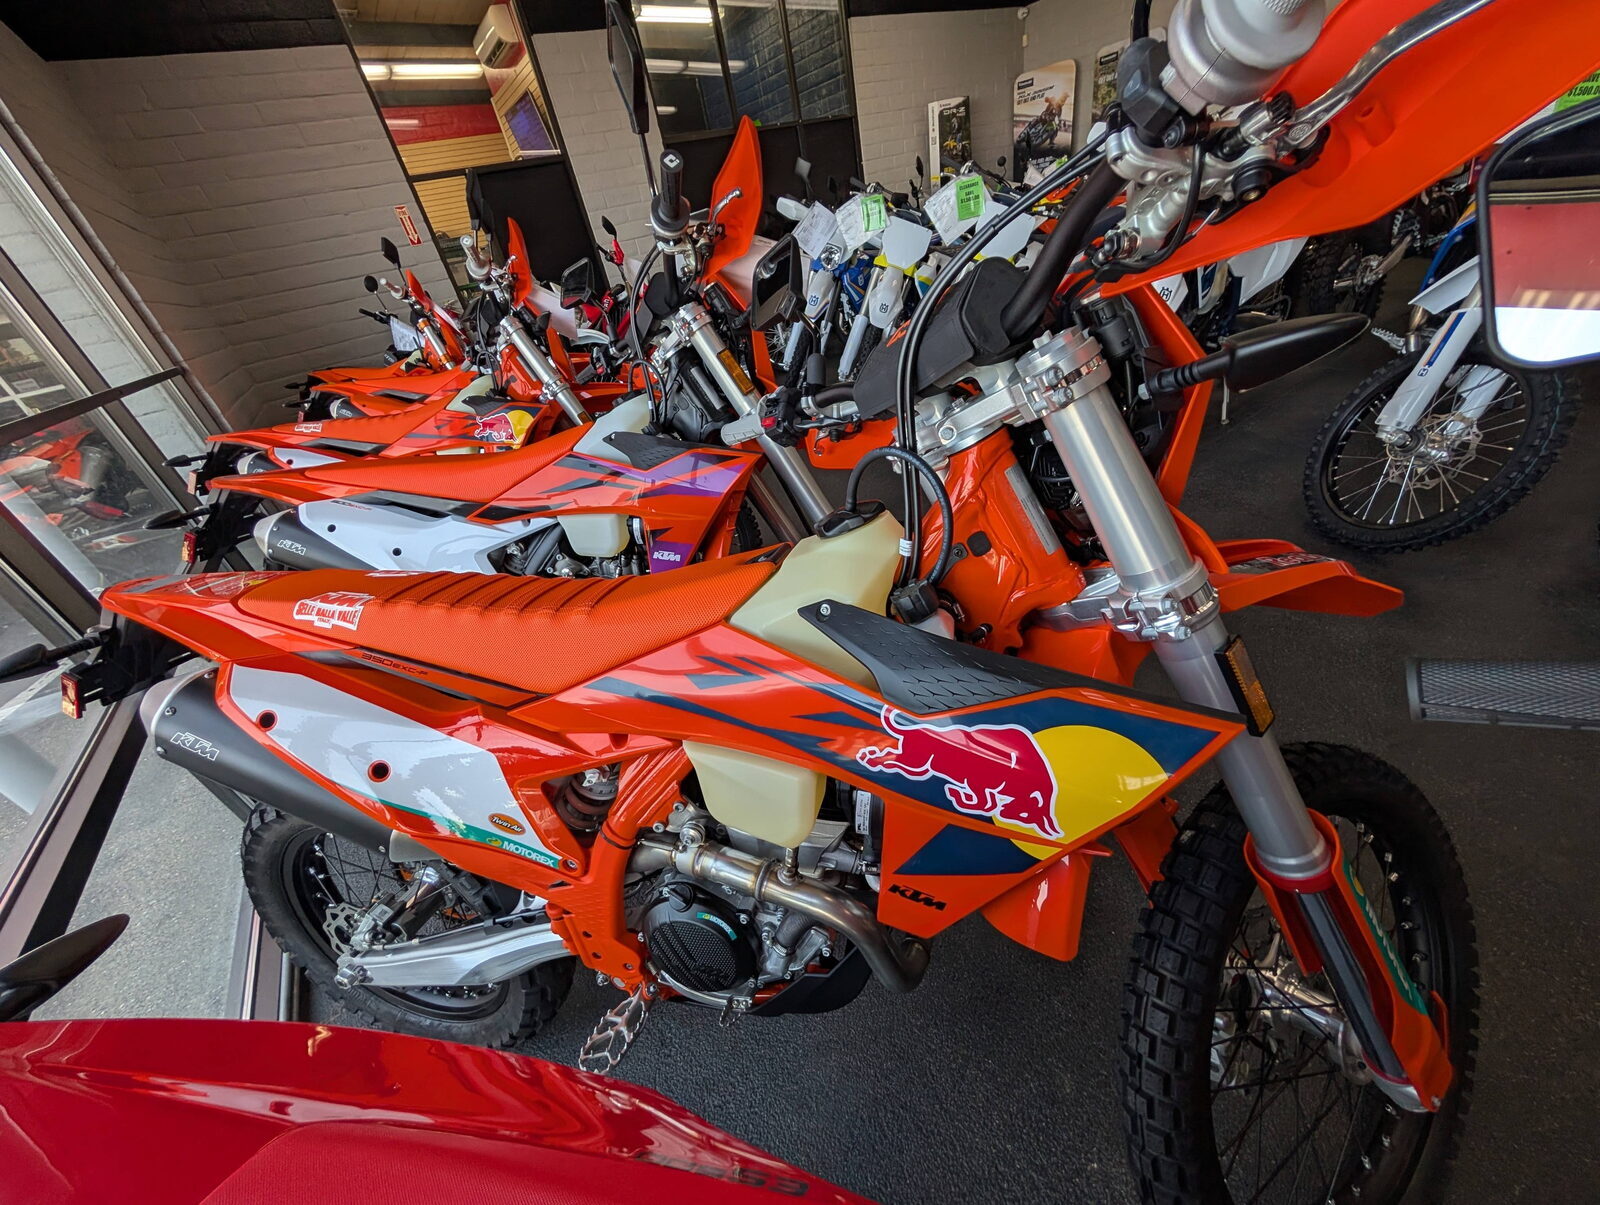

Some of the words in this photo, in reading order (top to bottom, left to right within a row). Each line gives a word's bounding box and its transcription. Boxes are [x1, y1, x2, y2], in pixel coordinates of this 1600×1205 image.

[277, 539, 307, 556] KTM
[652, 550, 681, 562] KTM
[295, 601, 316, 616] SELLE
[337, 609, 359, 625] VALLE
[170, 732, 220, 761] KTM
[492, 815, 511, 828] Twin
[510, 825, 523, 833] Air
[502, 840, 555, 868] MOTOREX
[888, 884, 947, 911] KTM
